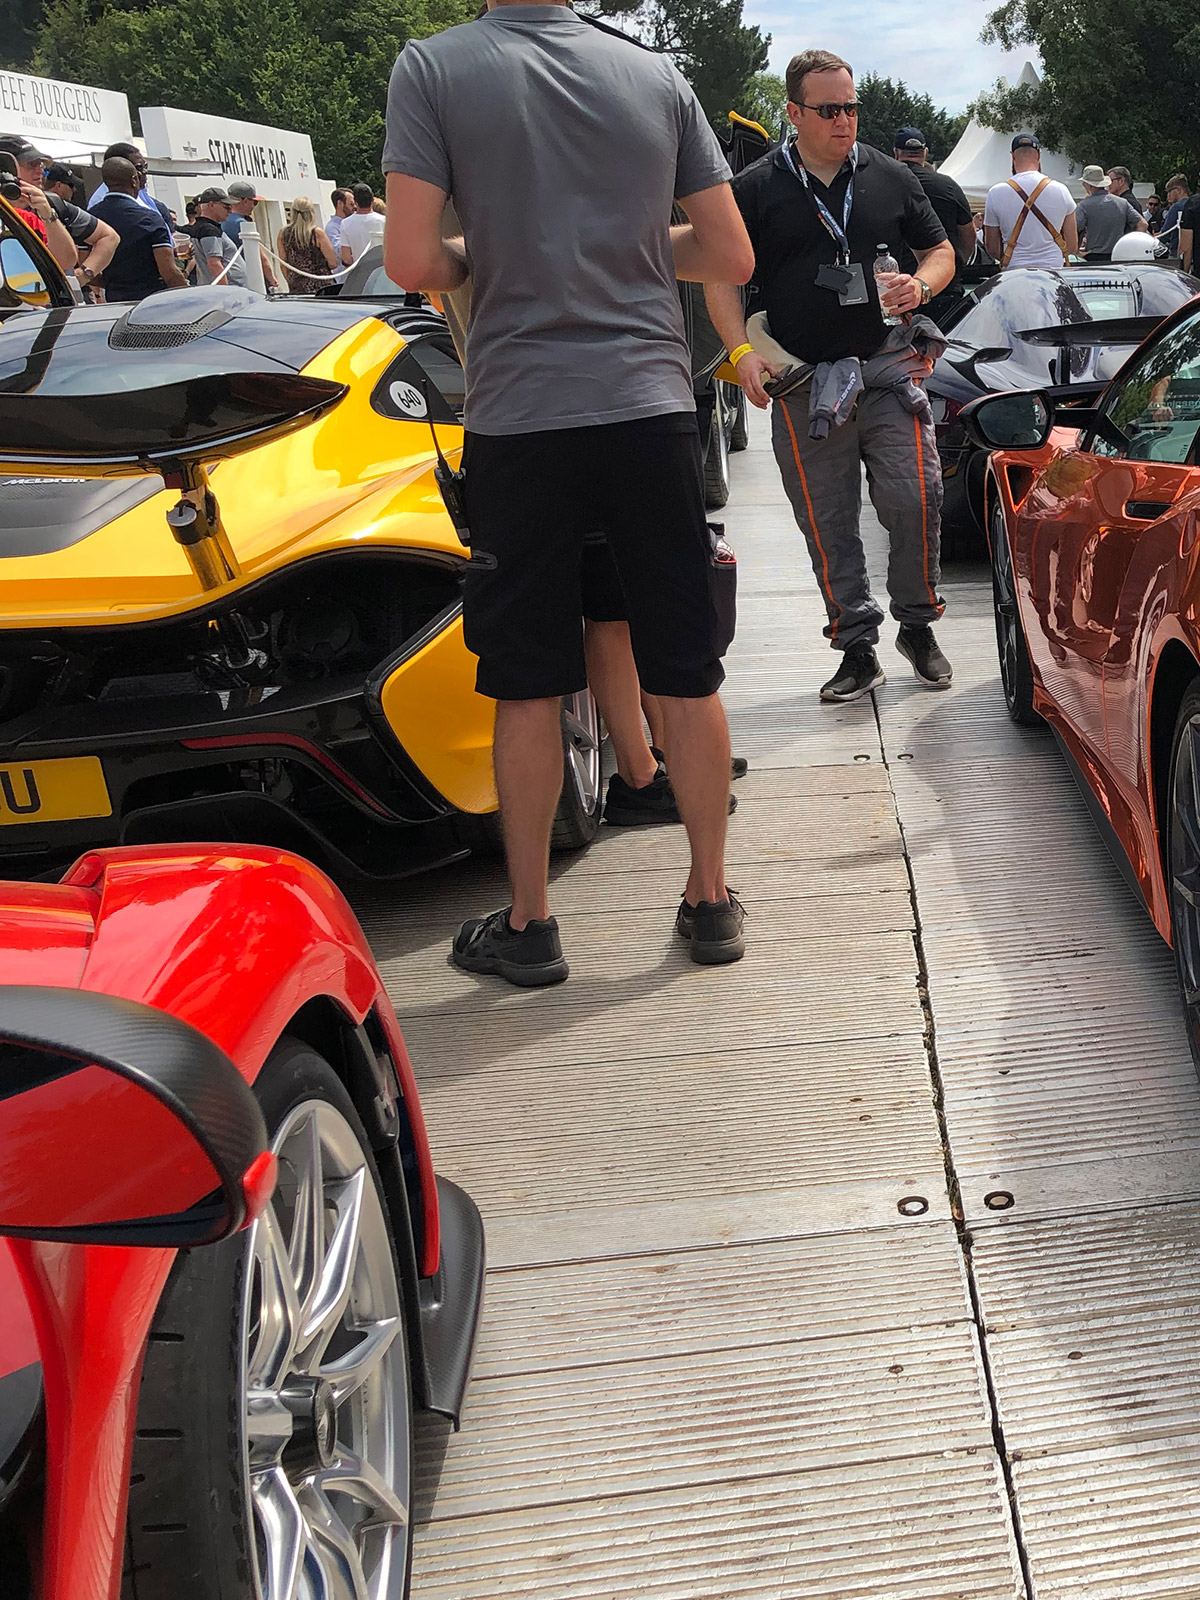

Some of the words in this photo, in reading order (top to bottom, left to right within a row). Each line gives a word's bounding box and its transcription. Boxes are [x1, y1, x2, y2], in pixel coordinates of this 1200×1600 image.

[31, 80, 102, 123] BURGERS
[208, 138, 268, 178] STARTLINE
[268, 148, 289, 181] BAR
[397, 388, 422, 409] 640
